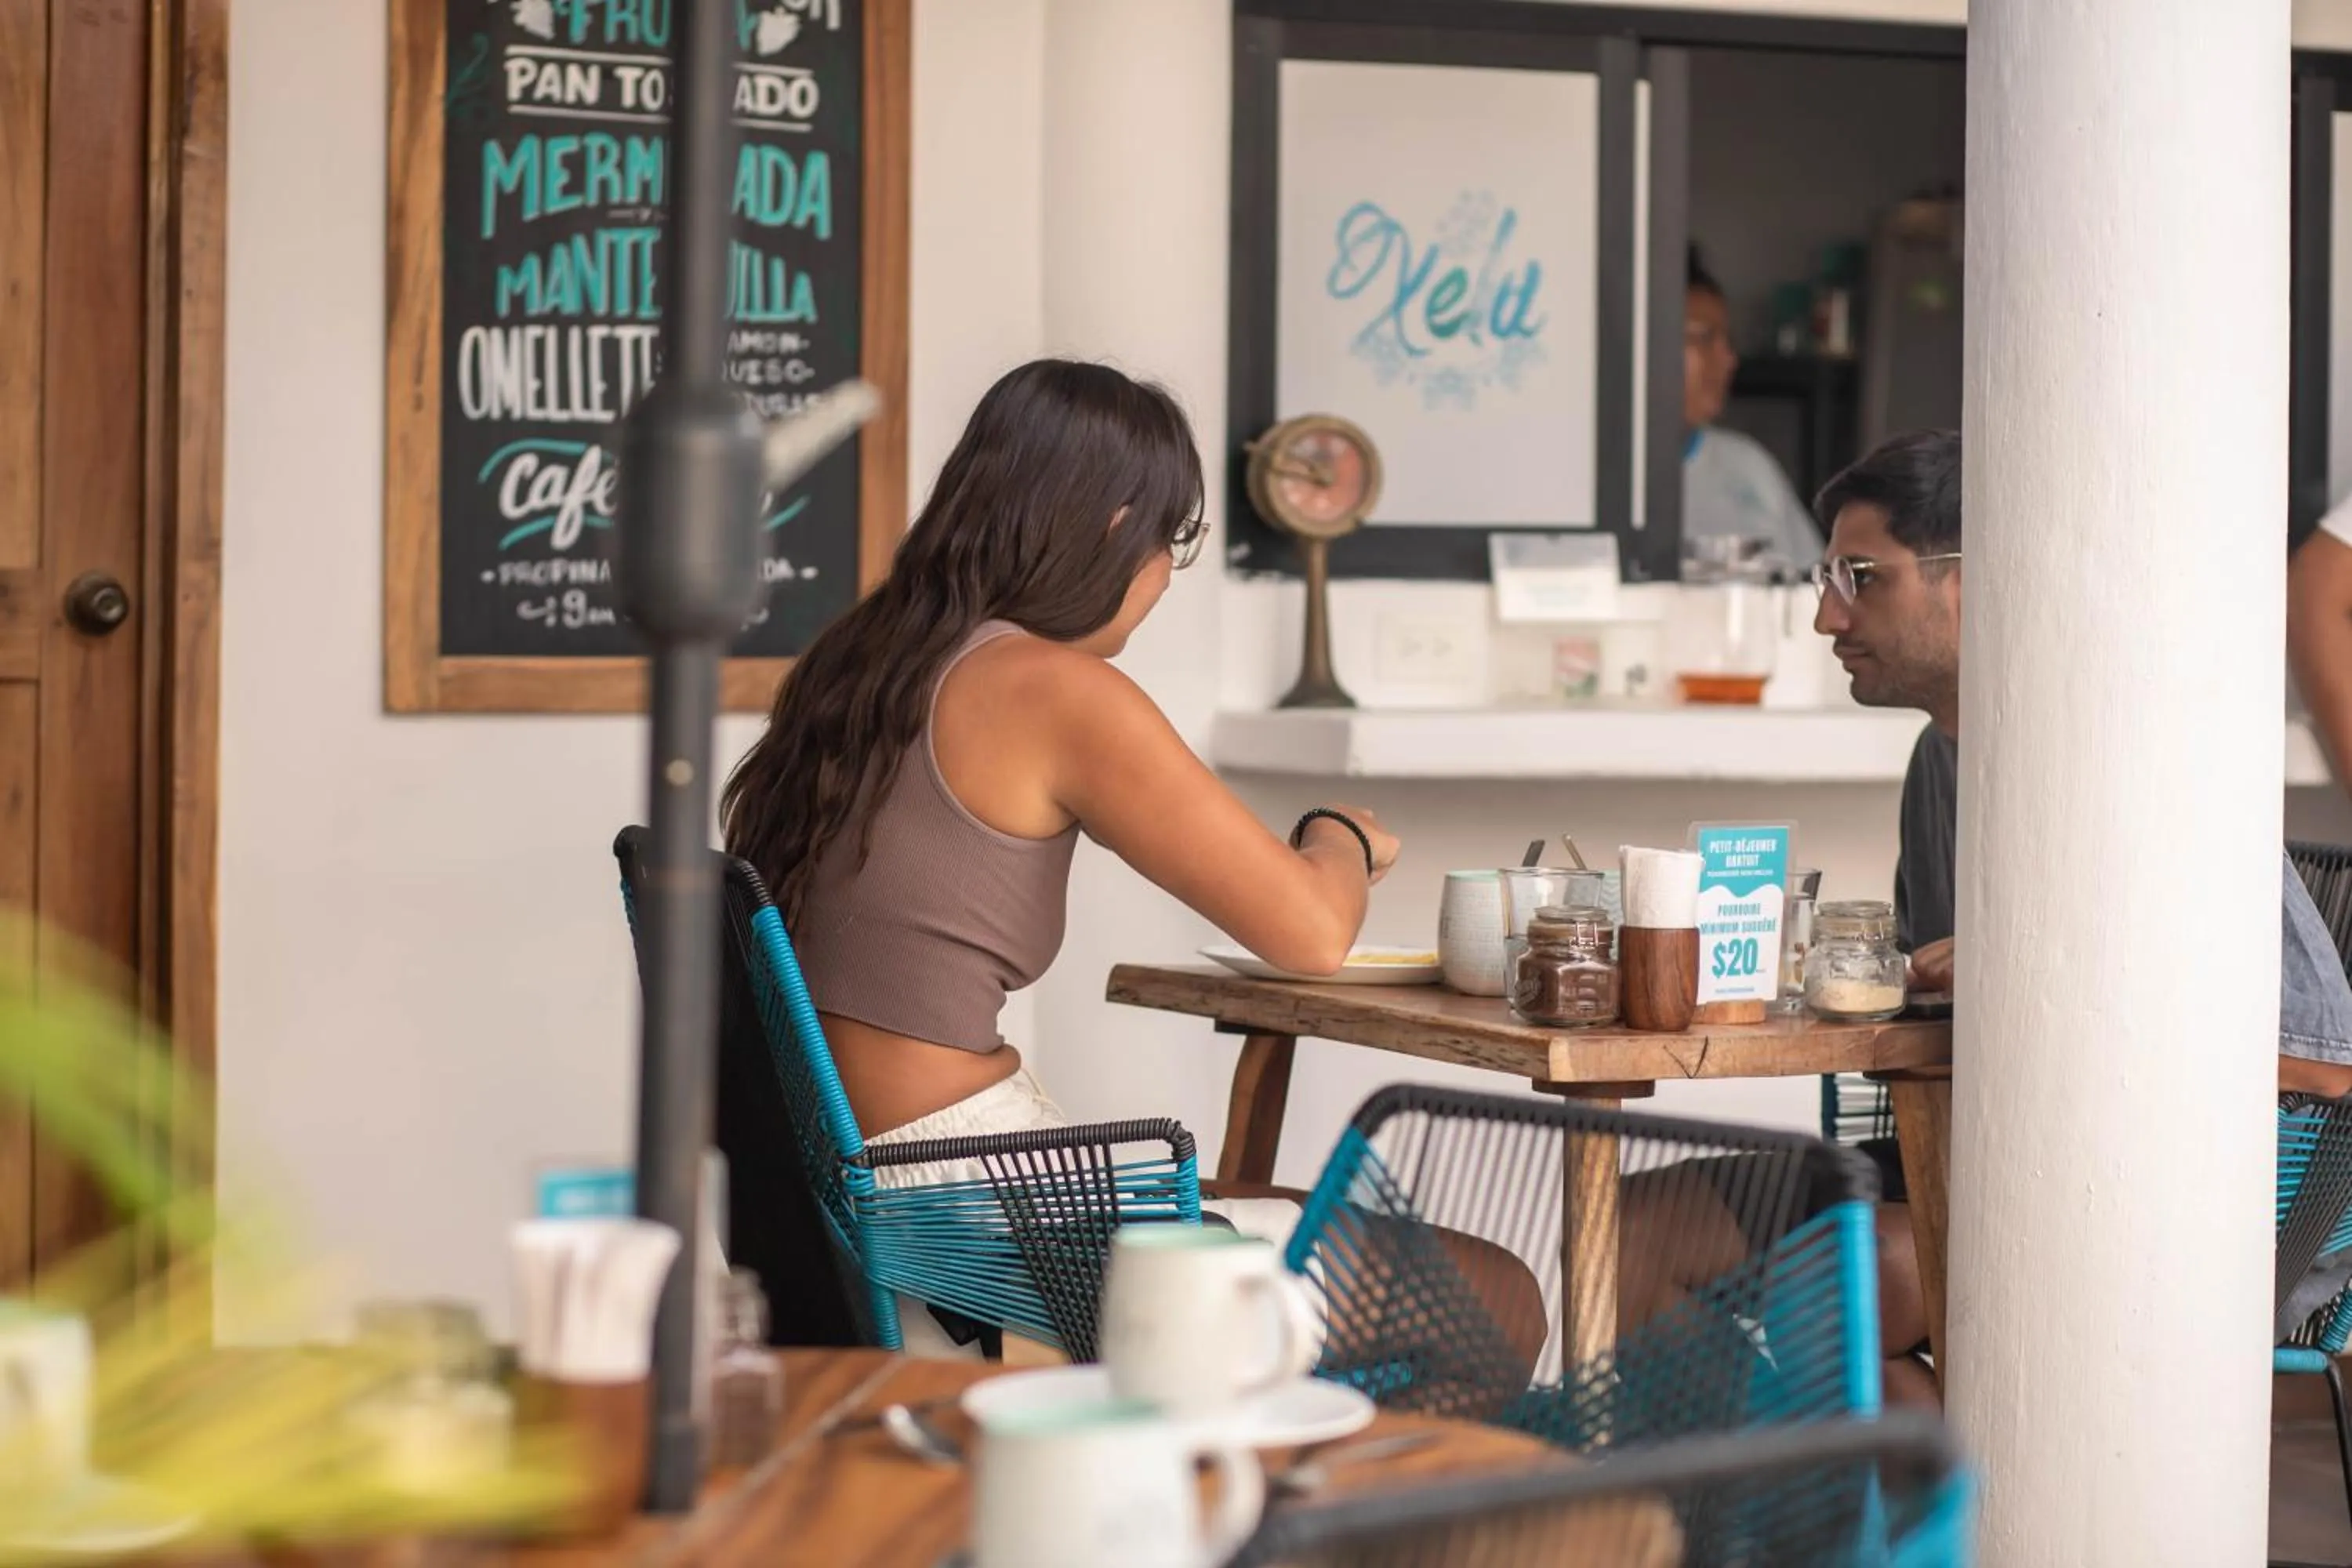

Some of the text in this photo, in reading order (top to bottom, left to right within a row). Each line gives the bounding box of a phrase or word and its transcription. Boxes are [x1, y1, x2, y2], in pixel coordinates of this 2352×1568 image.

[504, 58, 820, 118] PAN TOADO
[481, 132, 832, 240] MERMADA
[1711, 937, 1759, 979] $20
